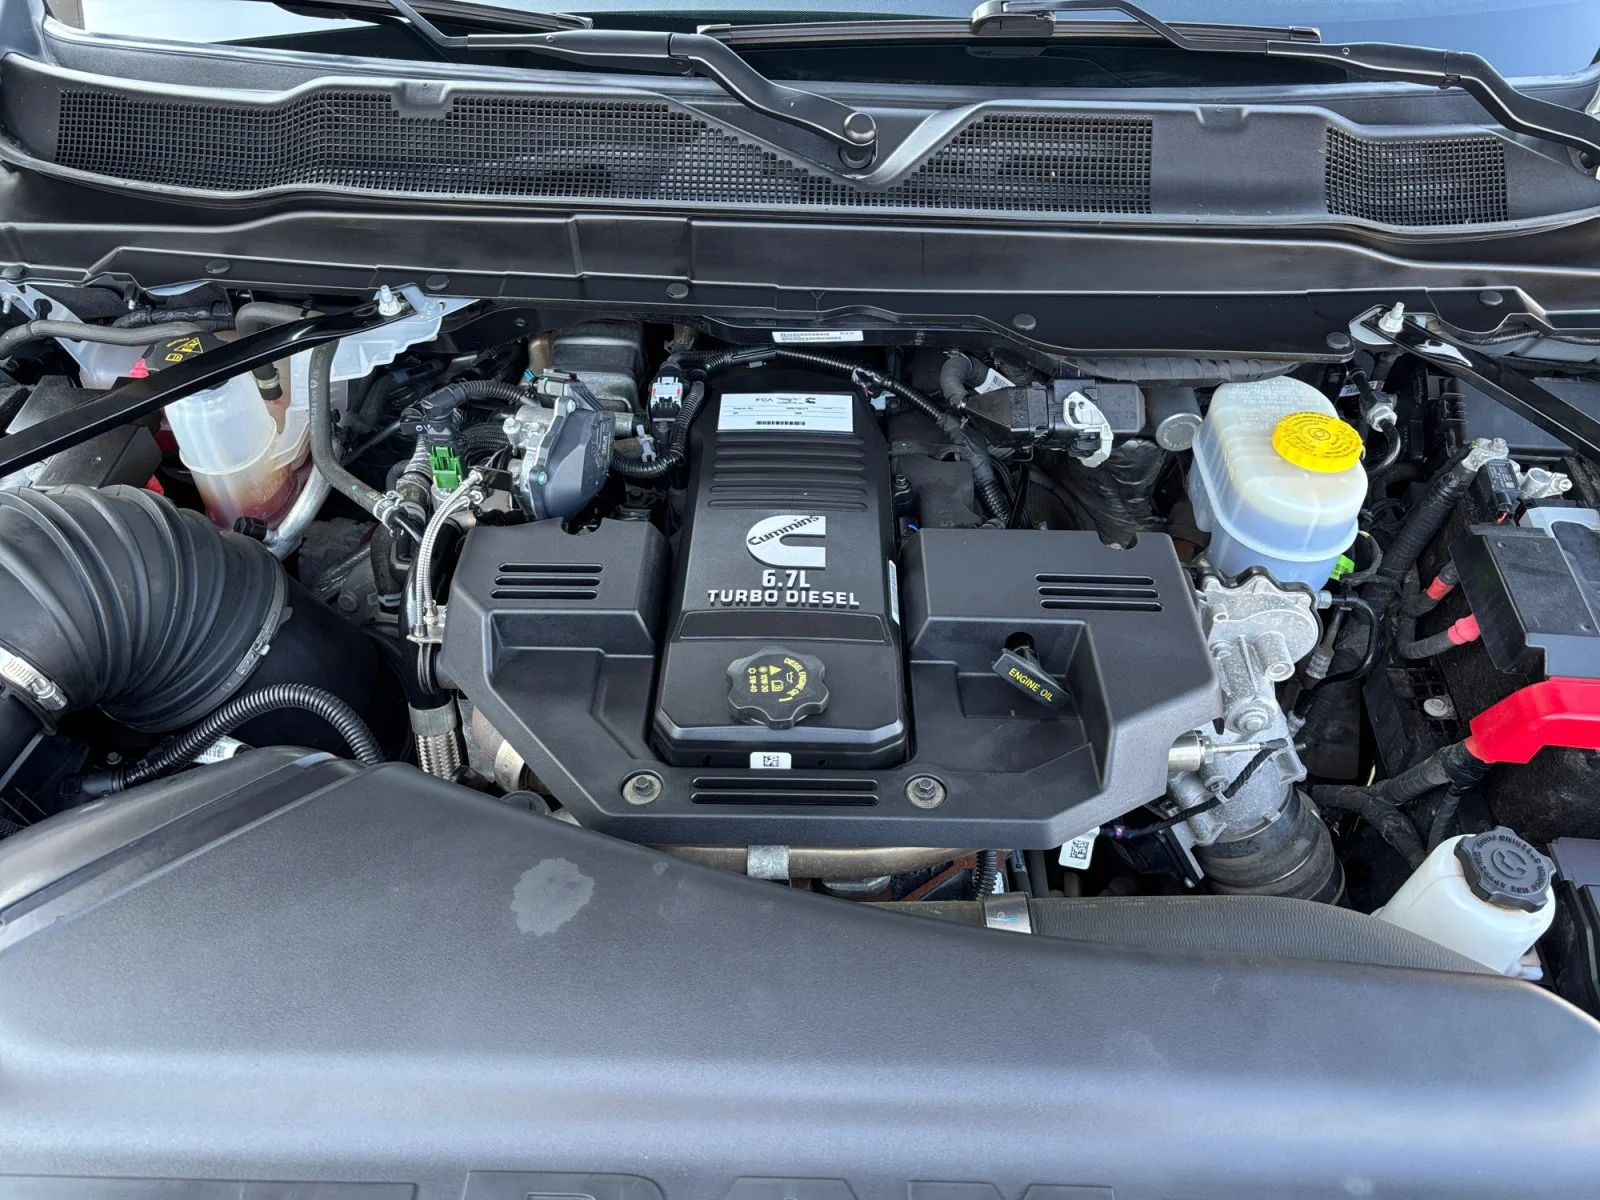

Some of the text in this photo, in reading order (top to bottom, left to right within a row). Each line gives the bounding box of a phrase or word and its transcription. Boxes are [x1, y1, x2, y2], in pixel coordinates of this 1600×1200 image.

[747, 515, 820, 546] Cummins
[762, 570, 811, 588] 6.7L
[708, 589, 860, 608] TURBO DIESEL
[1008, 667, 1054, 702] ENGINE OIL
